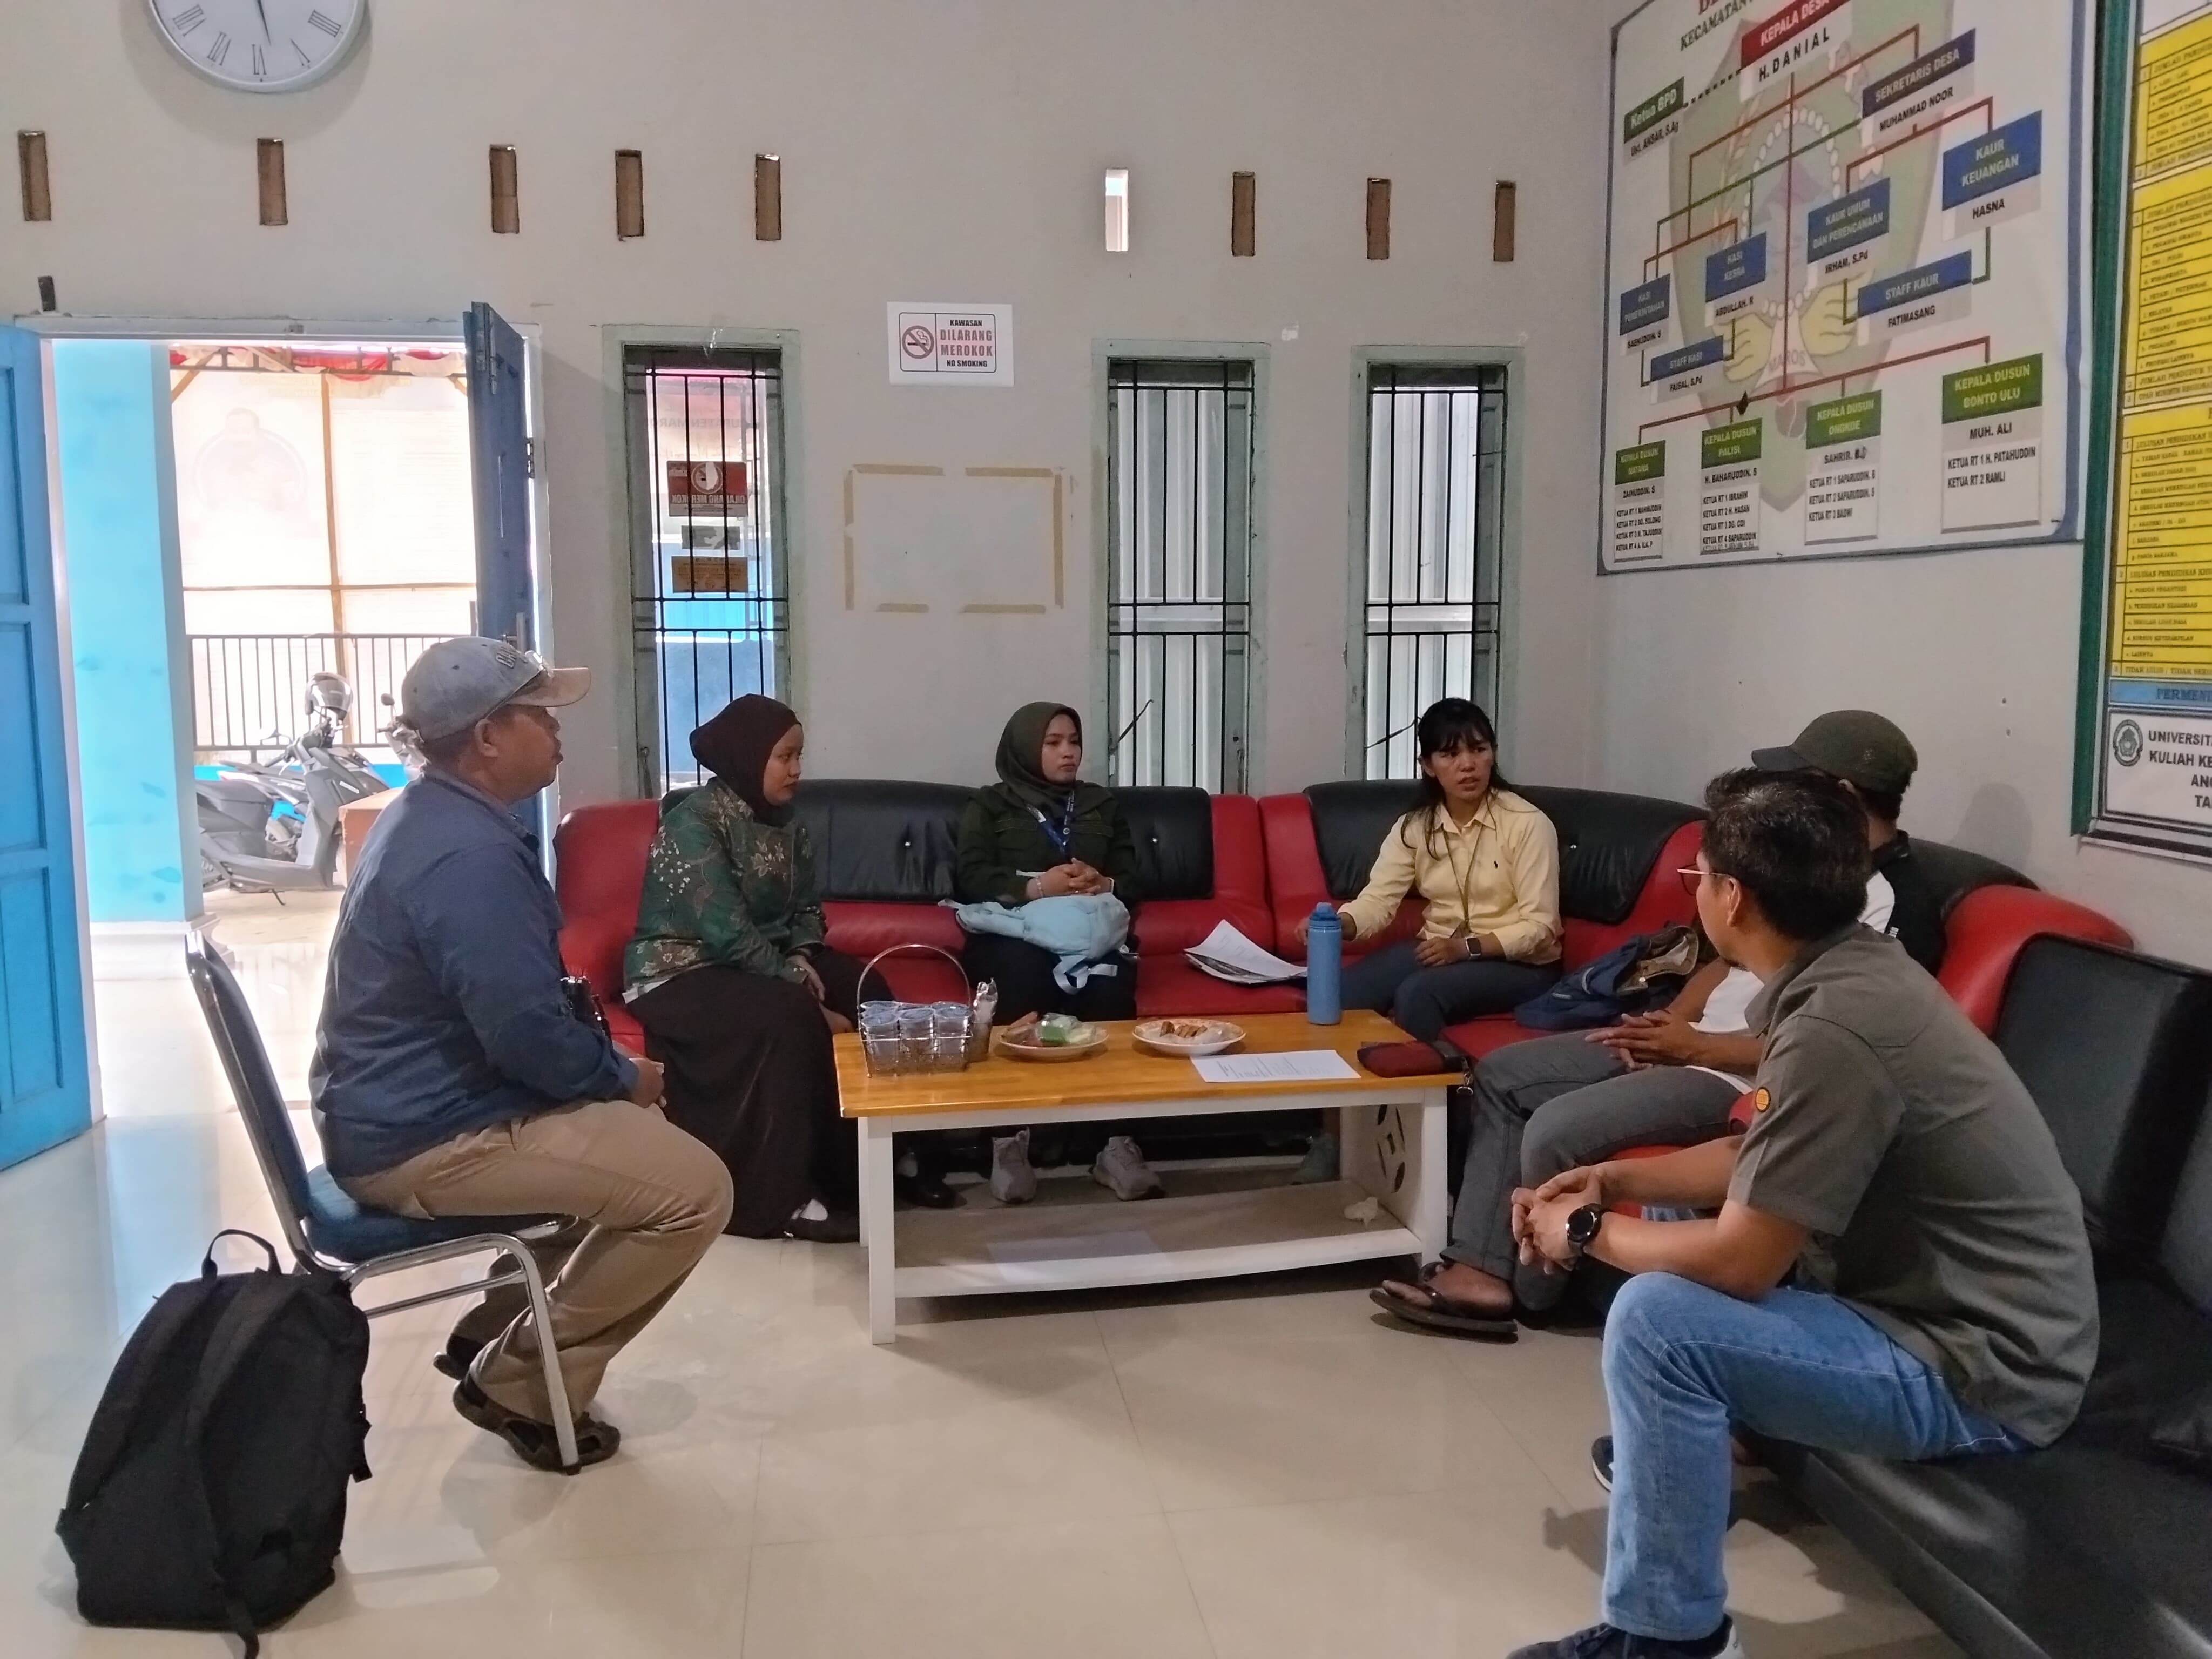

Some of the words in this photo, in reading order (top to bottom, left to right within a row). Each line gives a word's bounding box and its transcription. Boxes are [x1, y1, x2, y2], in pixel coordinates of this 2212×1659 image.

[1761, 10, 1799, 46] KEPALA
[1772, 27, 1830, 74] DANIAL
[1875, 63, 1932, 102] SEKRETARIS
[1934, 49, 1960, 72] DESA
[1658, 89, 1677, 111] BPD
[1879, 101, 1927, 131] MUHAMMAD
[1929, 87, 1953, 108] NOOR
[1976, 139, 2005, 161] KAUR
[1961, 154, 2019, 187] KEUANGAN
[1972, 198, 2005, 219] HASNA
[1886, 282, 1911, 300] STAFF
[1914, 273, 1939, 292] KAUR
[1888, 305, 1936, 328] FATIMASANG
[940, 329, 993, 341] DILARANG
[940, 345, 993, 356] MEROKOK
[1670, 355, 1687, 369] STAFF
[1955, 374, 1992, 391] KEPALA
[1994, 364, 2030, 382] DUSUN
[1963, 392, 1997, 408] BONTO
[2000, 387, 2020, 401] ULU
[1817, 406, 1845, 421] KEPALA
[1847, 399, 1874, 415] DUSUN
[1704, 431, 1730, 445] KEPALA
[1731, 427, 1756, 439] DUSUN
[1970, 426, 1994, 439] MUH.
[1997, 422, 2012, 435] ALI
[1948, 458, 1968, 469] KETUA
[1971, 455, 1978, 466] RT
[1981, 454, 1984, 465] 1
[1994, 446, 2036, 462] PATAHUDDIN
[1810, 478, 1825, 488] KETUA
[1826, 476, 1832, 485] RT
[1948, 477, 1968, 488] KETUA
[1970, 475, 1978, 485] RT
[1980, 474, 1984, 484] 2
[1986, 471, 2005, 483] RAMLI
[1703, 496, 1717, 504] KETUA
[1809, 495, 1825, 505] KETUA
[1825, 494, 1832, 502] RT
[1703, 510, 1717, 518] KETUA
[1809, 511, 1824, 521] KETUA
[1825, 510, 1832, 519] RT
[2149, 730, 2212, 746] UNIVERSIT
[2149, 750, 2194, 766] KULIAH
